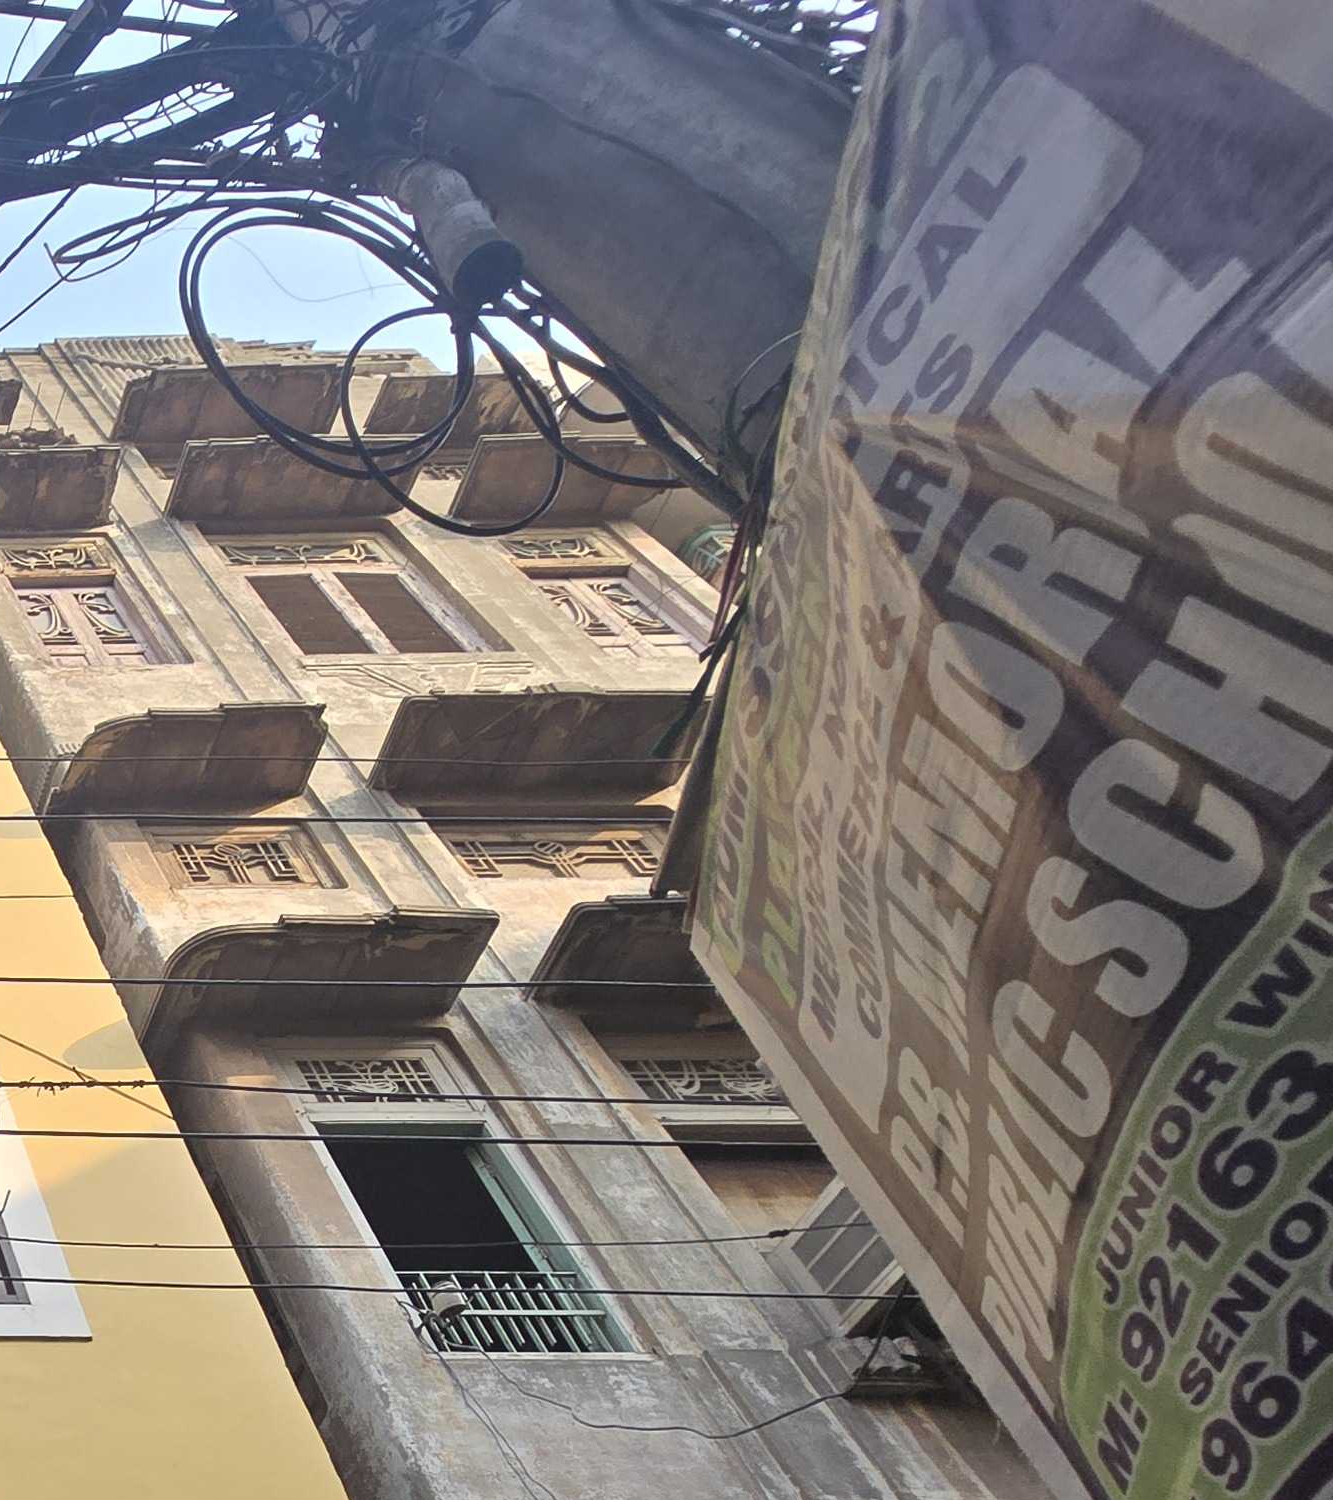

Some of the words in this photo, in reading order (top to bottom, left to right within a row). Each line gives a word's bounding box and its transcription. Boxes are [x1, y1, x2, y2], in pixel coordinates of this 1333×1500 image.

[860, 603, 906, 670] &
[883, 223, 1253, 1074] MEMORIAL
[980, 977, 1112, 1364] PUBLIC
[1096, 1050, 1239, 1305] JUNIOR
[1121, 1050, 1333, 1383] 92163
[1097, 1389, 1148, 1494] M:
[1201, 1265, 1333, 1493] 964
